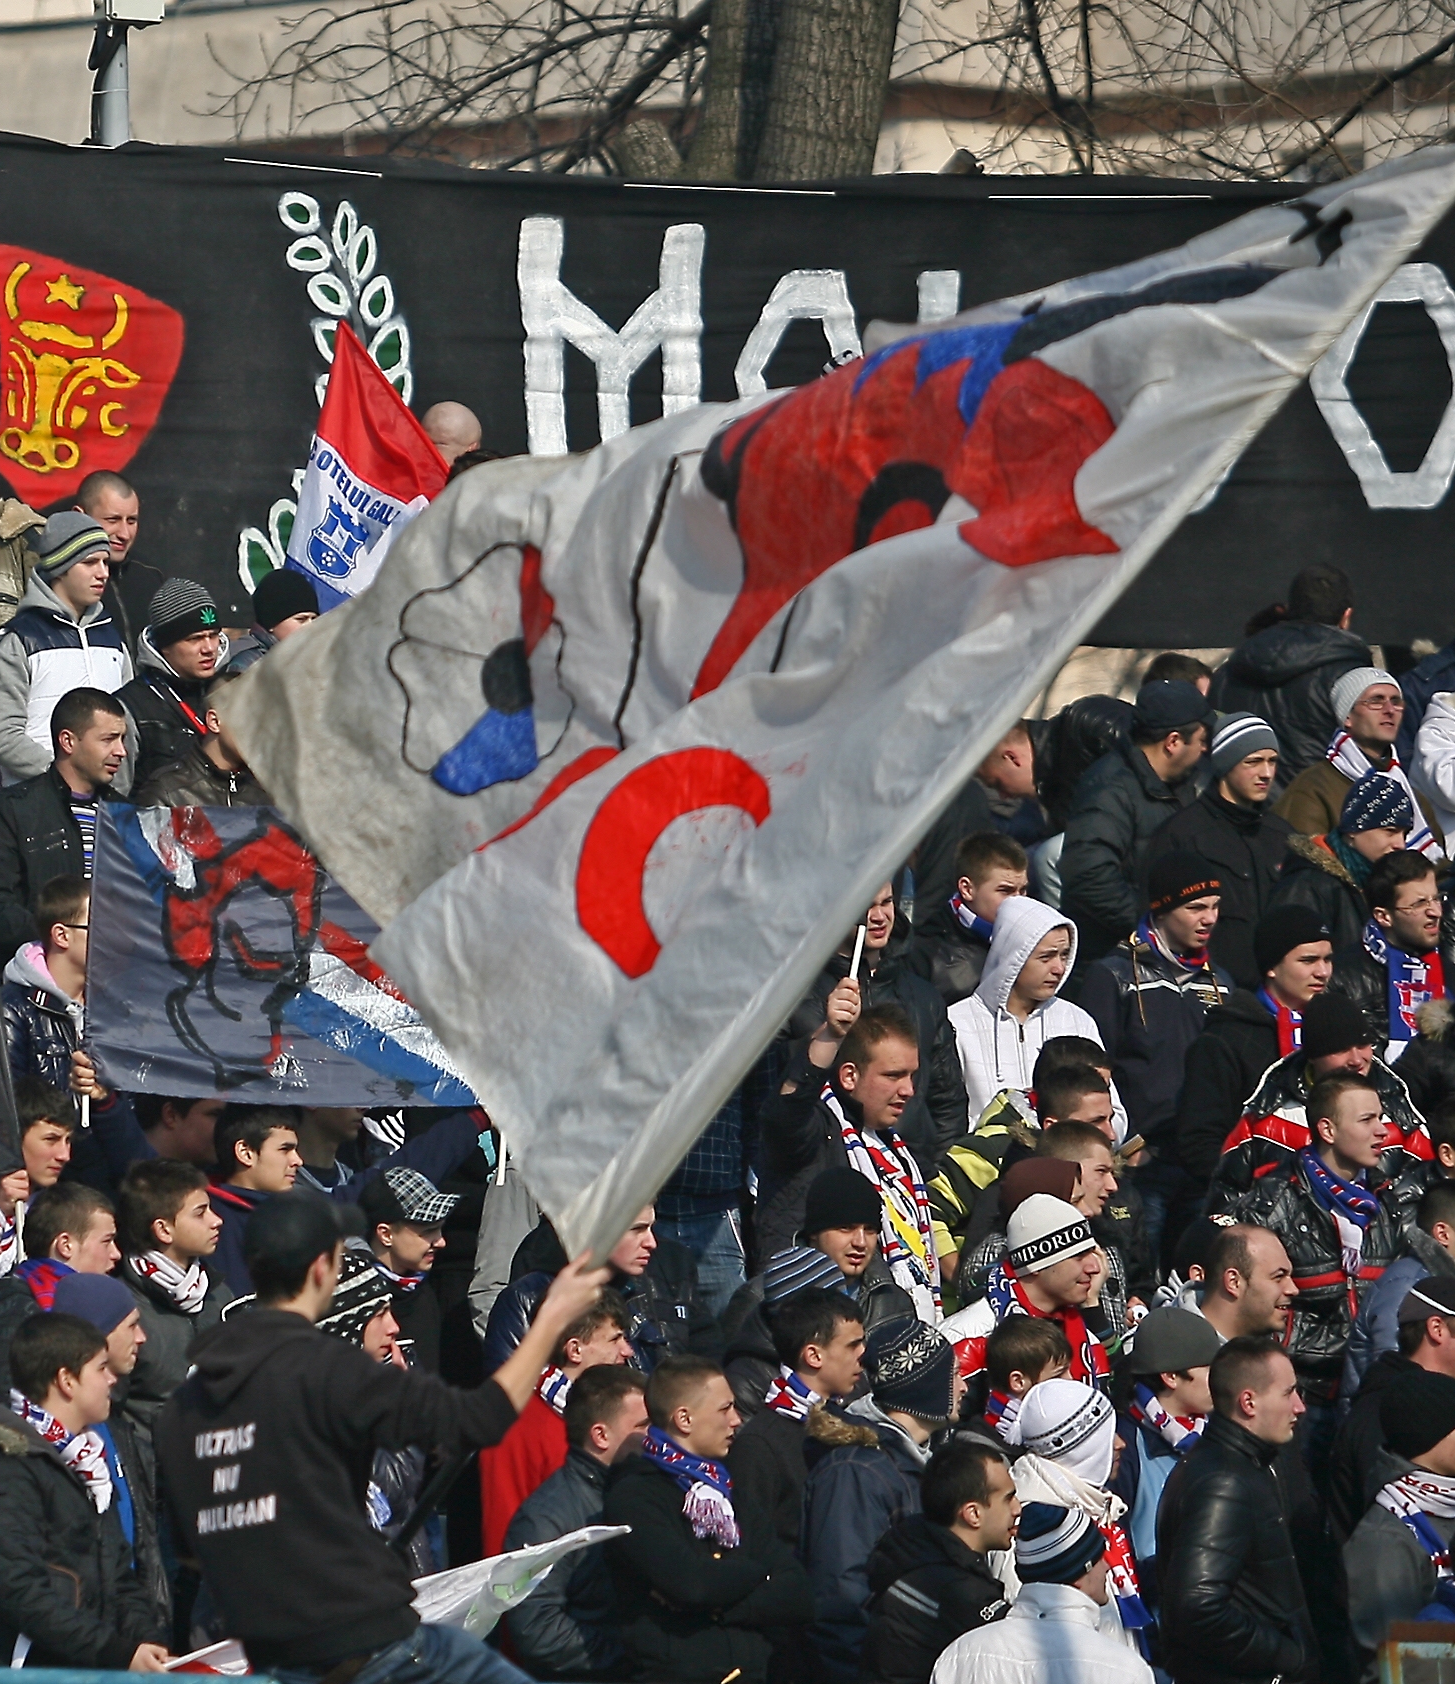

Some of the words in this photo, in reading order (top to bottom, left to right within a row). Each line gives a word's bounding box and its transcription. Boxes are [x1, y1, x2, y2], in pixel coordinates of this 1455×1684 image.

[1179, 881, 1207, 897] JUST
[194, 1422, 257, 1459] ULTRAS
[212, 1463, 242, 1495] NU
